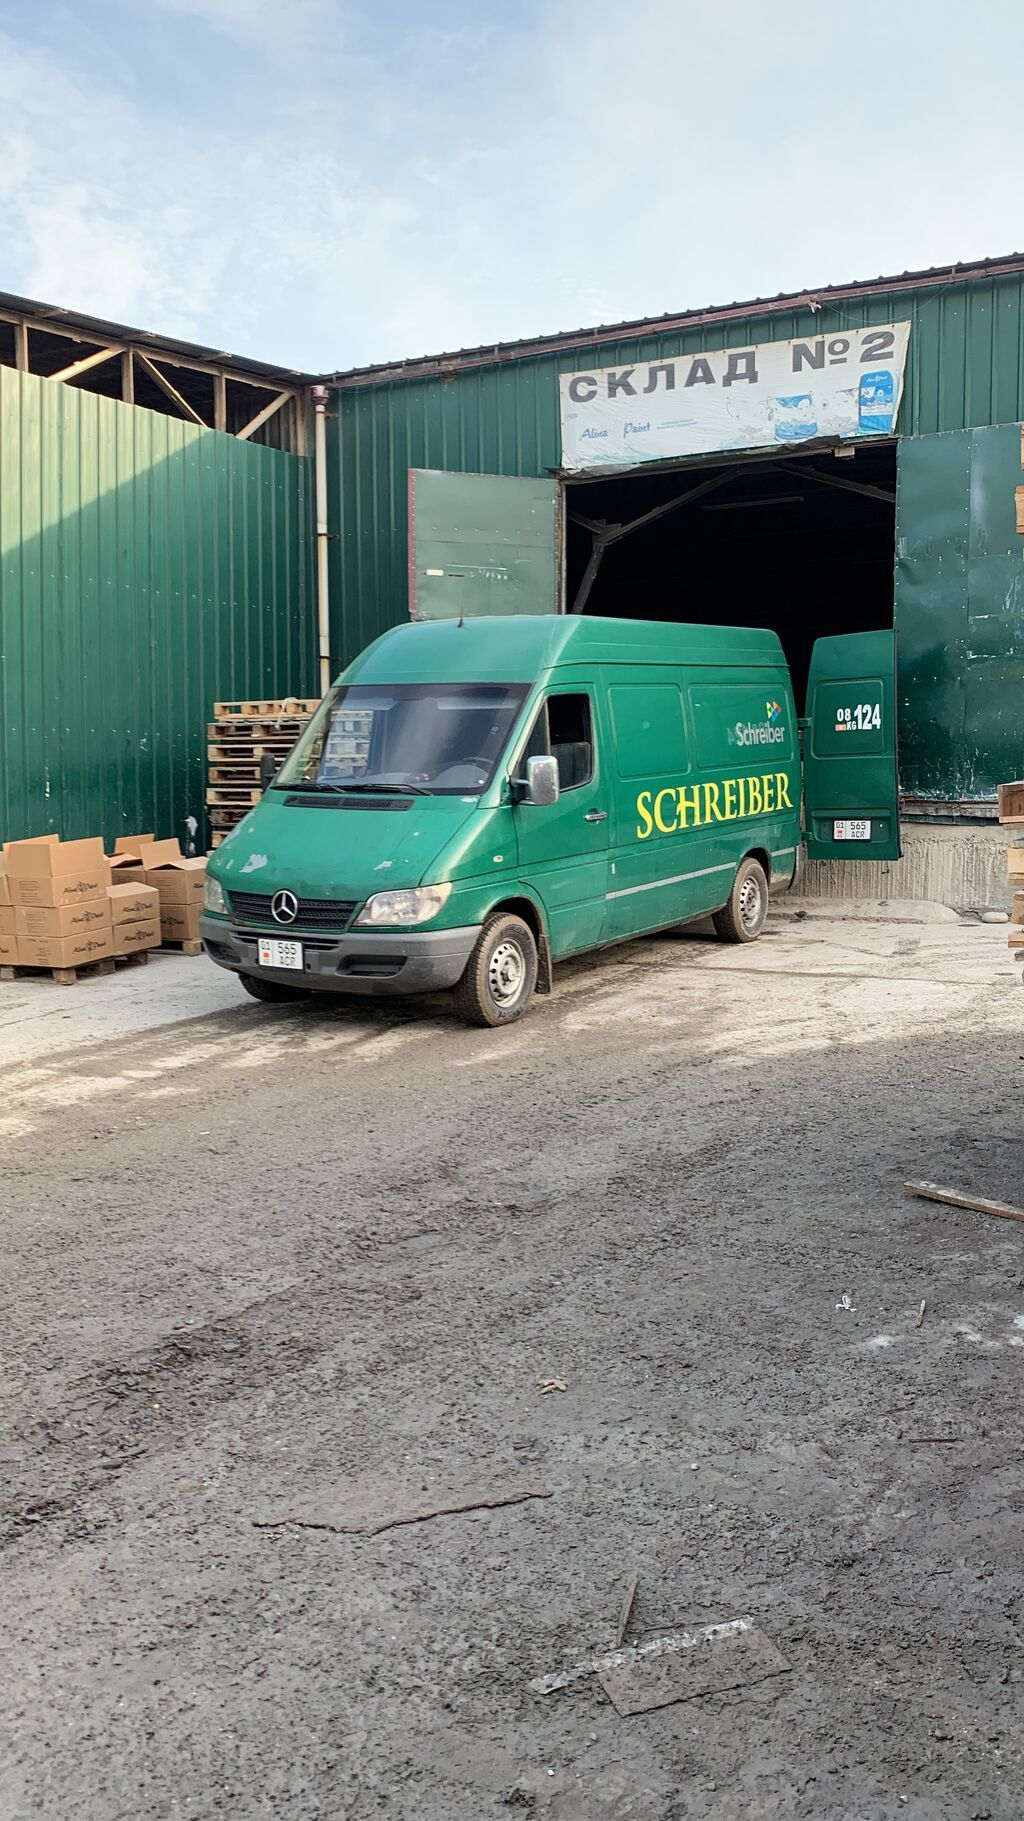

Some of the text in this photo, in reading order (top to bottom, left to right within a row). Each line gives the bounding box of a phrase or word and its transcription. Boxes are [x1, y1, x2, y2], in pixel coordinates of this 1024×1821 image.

[569, 351, 758, 403] СКЛАД
[623, 421, 651, 439] Paint
[836, 703, 882, 730] 08 124
[846, 720, 857, 731] KG
[735, 720, 785, 747] Schreiber
[636, 772, 794, 839] SCHREIBER
[850, 821, 867, 830] 565
[277, 942, 297, 955] 565
